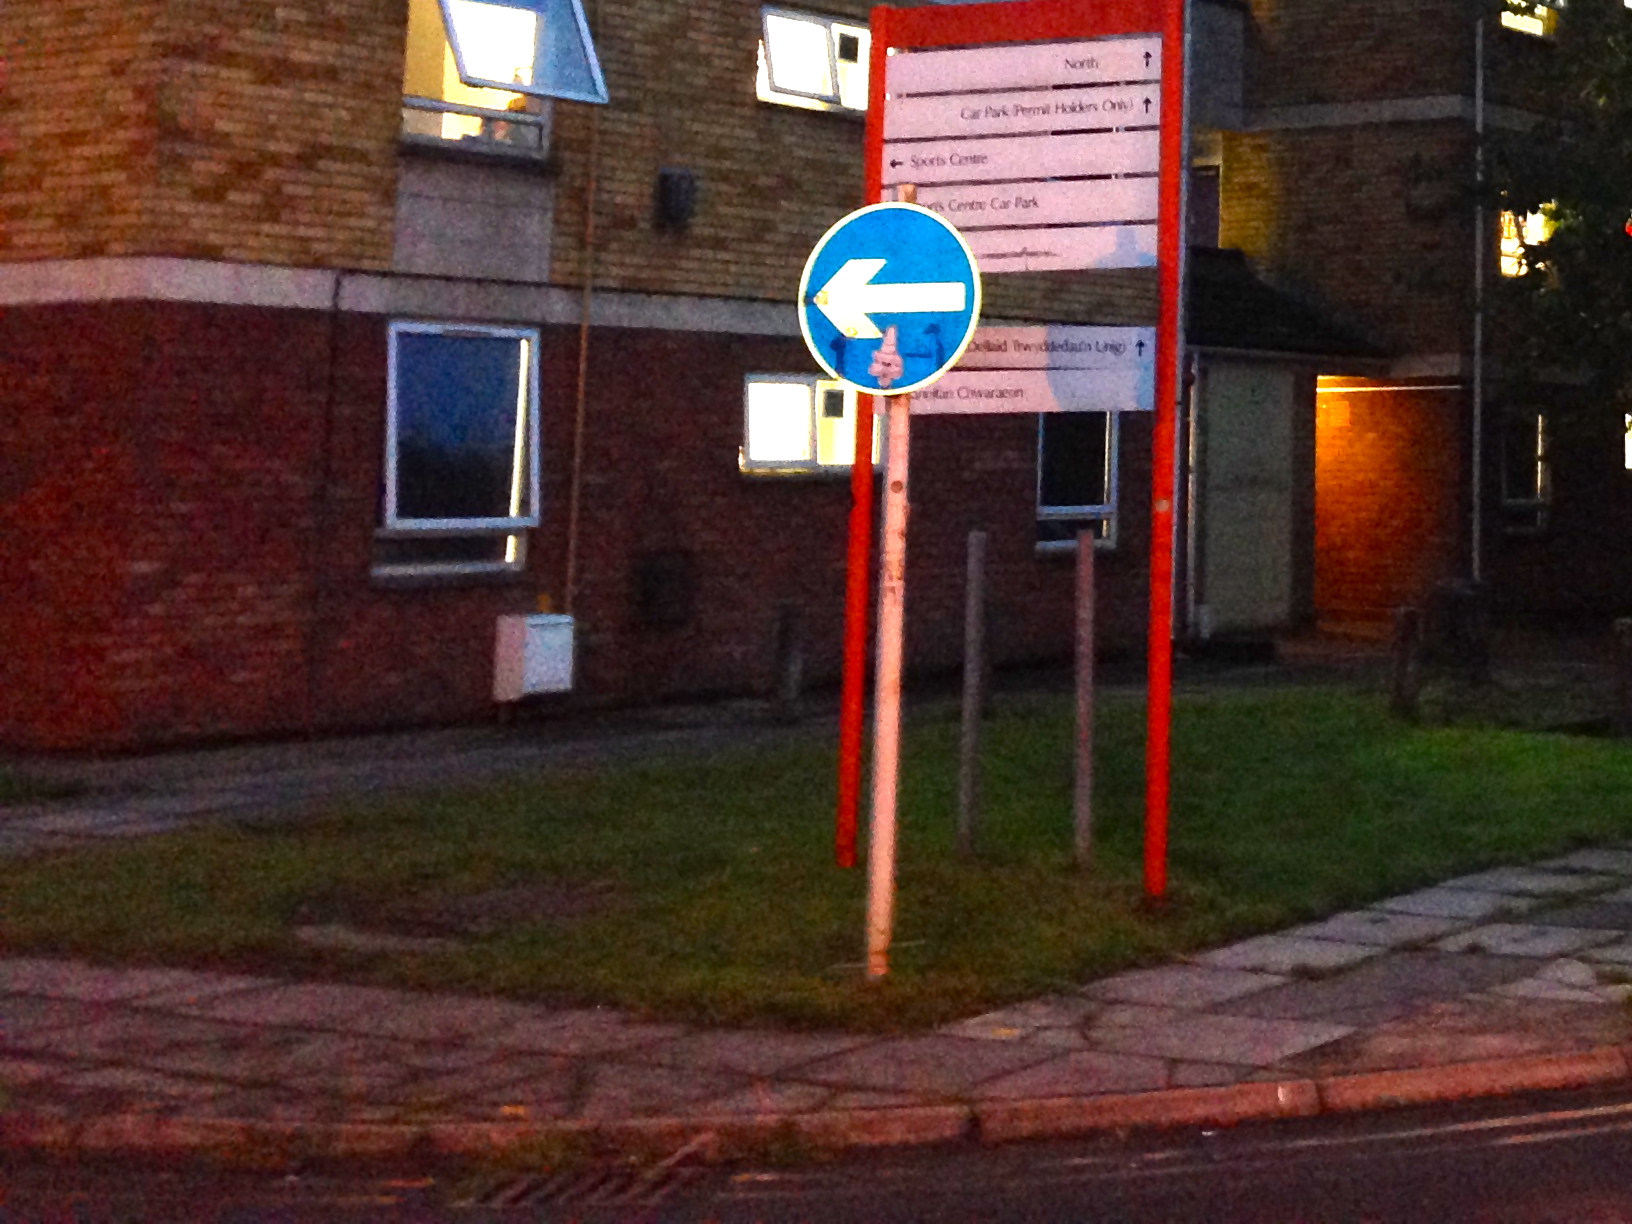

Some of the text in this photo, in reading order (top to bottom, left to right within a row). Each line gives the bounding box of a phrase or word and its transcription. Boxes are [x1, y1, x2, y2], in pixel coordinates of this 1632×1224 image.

[1065, 57, 1099, 69] North
[961, 107, 980, 120] Car
[985, 105, 1009, 118] Park
[1055, 100, 1098, 115] Holders
[910, 153, 988, 169] Sports Centre
[948, 199, 986, 212] Centre
[990, 197, 1011, 210] Car
[1015, 195, 1039, 209] Park
